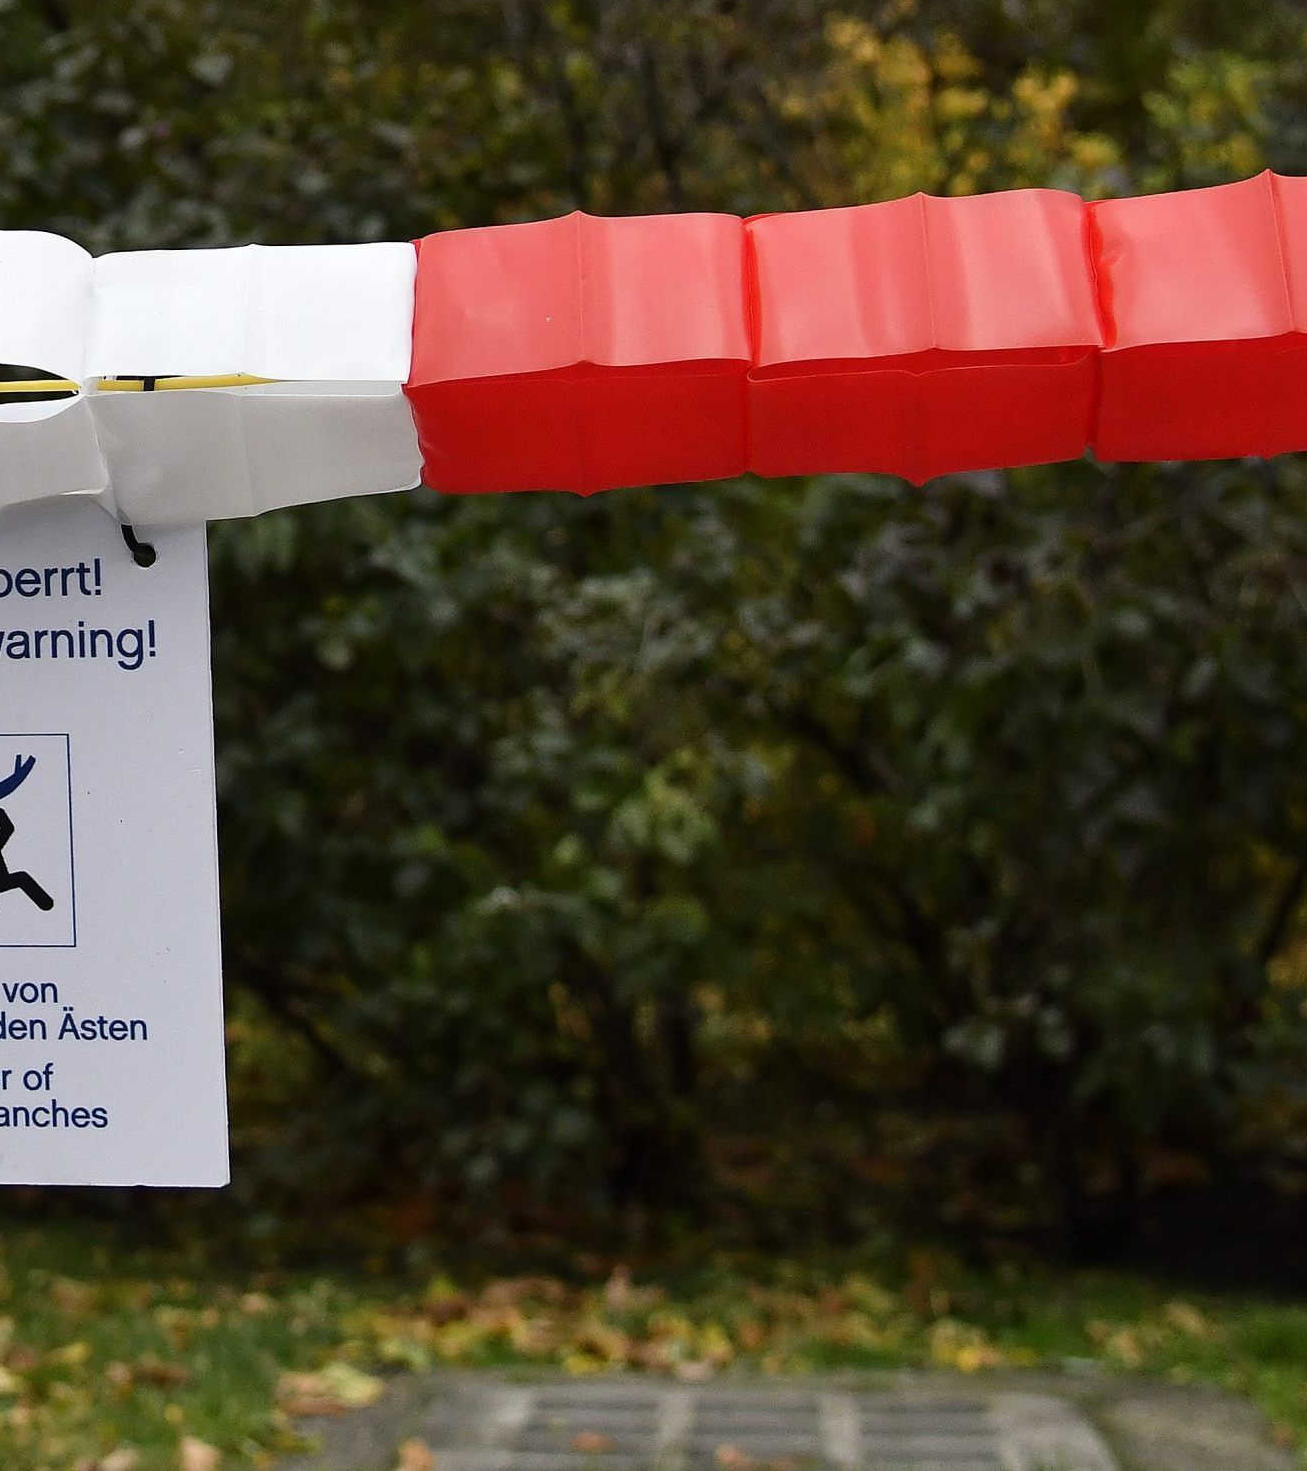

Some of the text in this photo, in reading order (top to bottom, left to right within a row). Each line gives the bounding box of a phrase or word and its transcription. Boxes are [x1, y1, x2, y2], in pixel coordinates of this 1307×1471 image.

[1, 982, 59, 1004] von
[57, 1005, 148, 1041] Ästen
[22, 1062, 54, 1092] of
